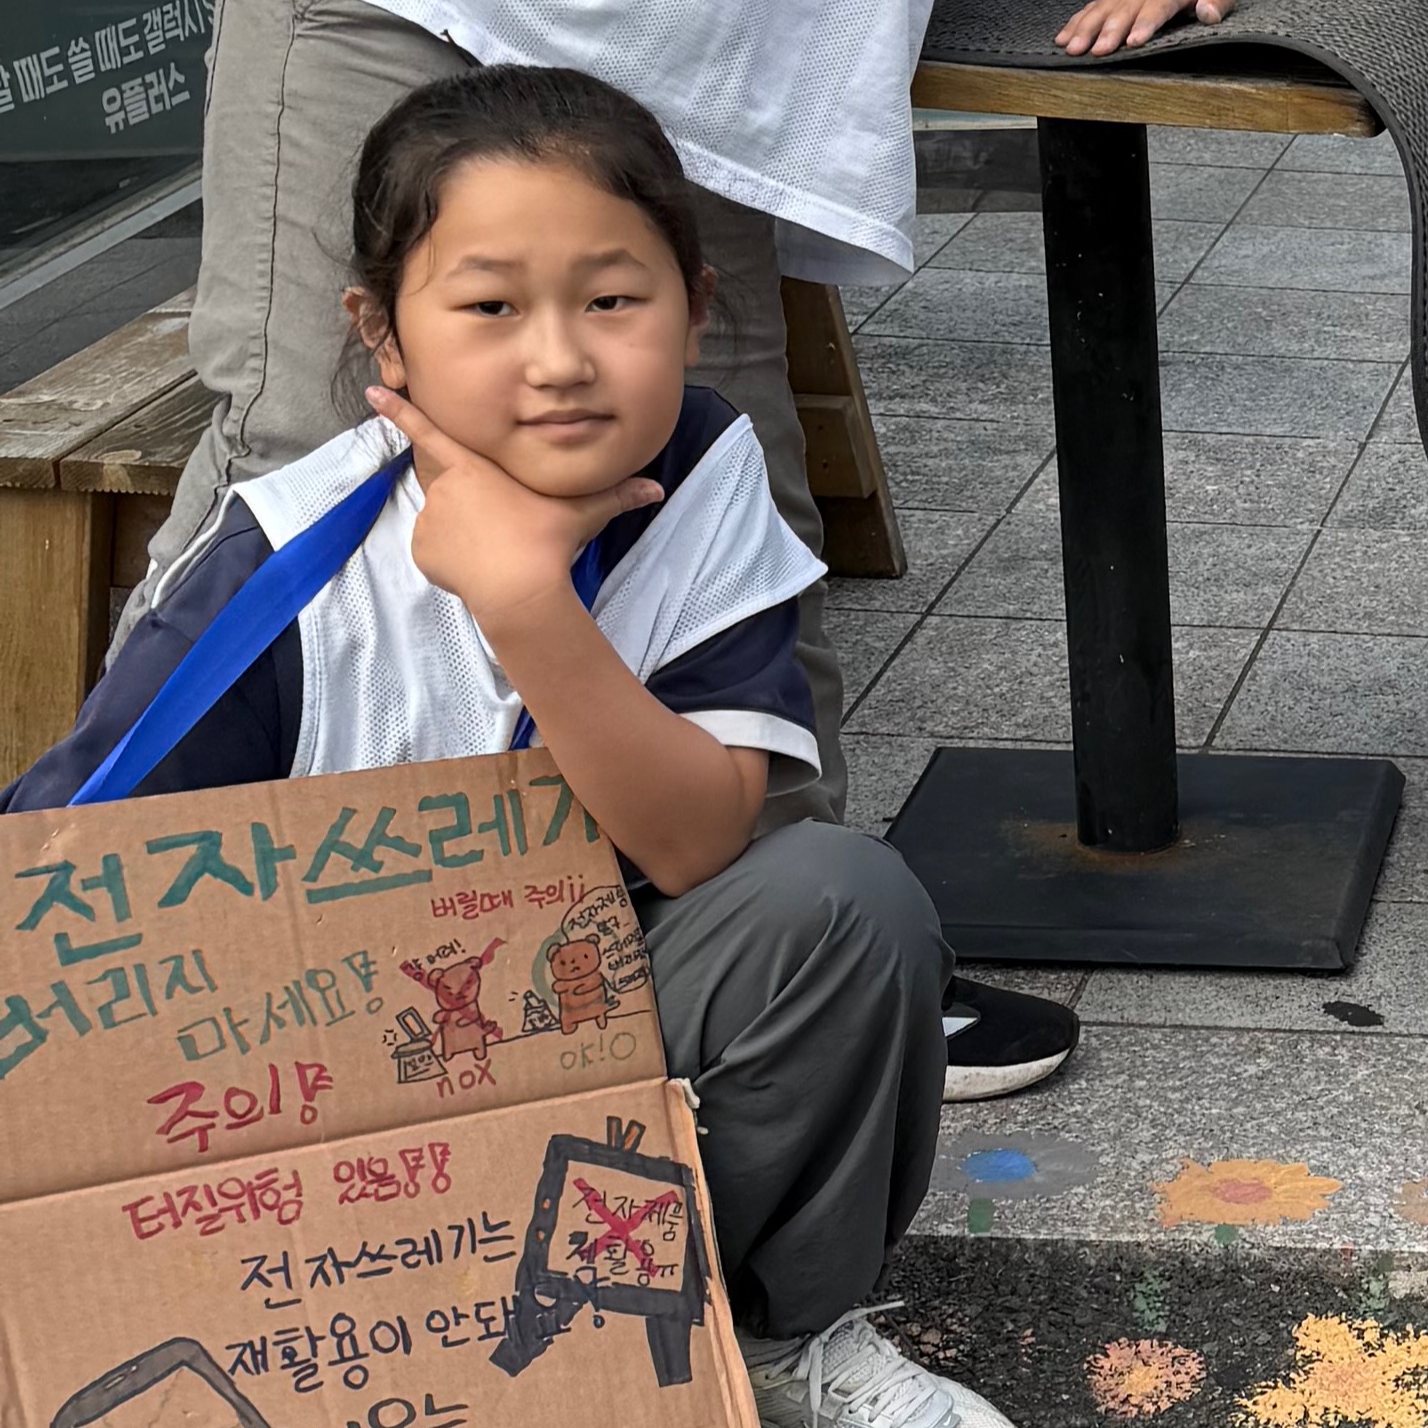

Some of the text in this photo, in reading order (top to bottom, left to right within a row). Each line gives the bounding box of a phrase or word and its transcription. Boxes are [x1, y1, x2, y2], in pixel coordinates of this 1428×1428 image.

[102, 67, 191, 135] 유플러스
[15, 774, 600, 968] 전자쓰레기
[240, 1210, 518, 1311] 전자쓰레기는
[225, 1312, 413, 1392] 재활용이
